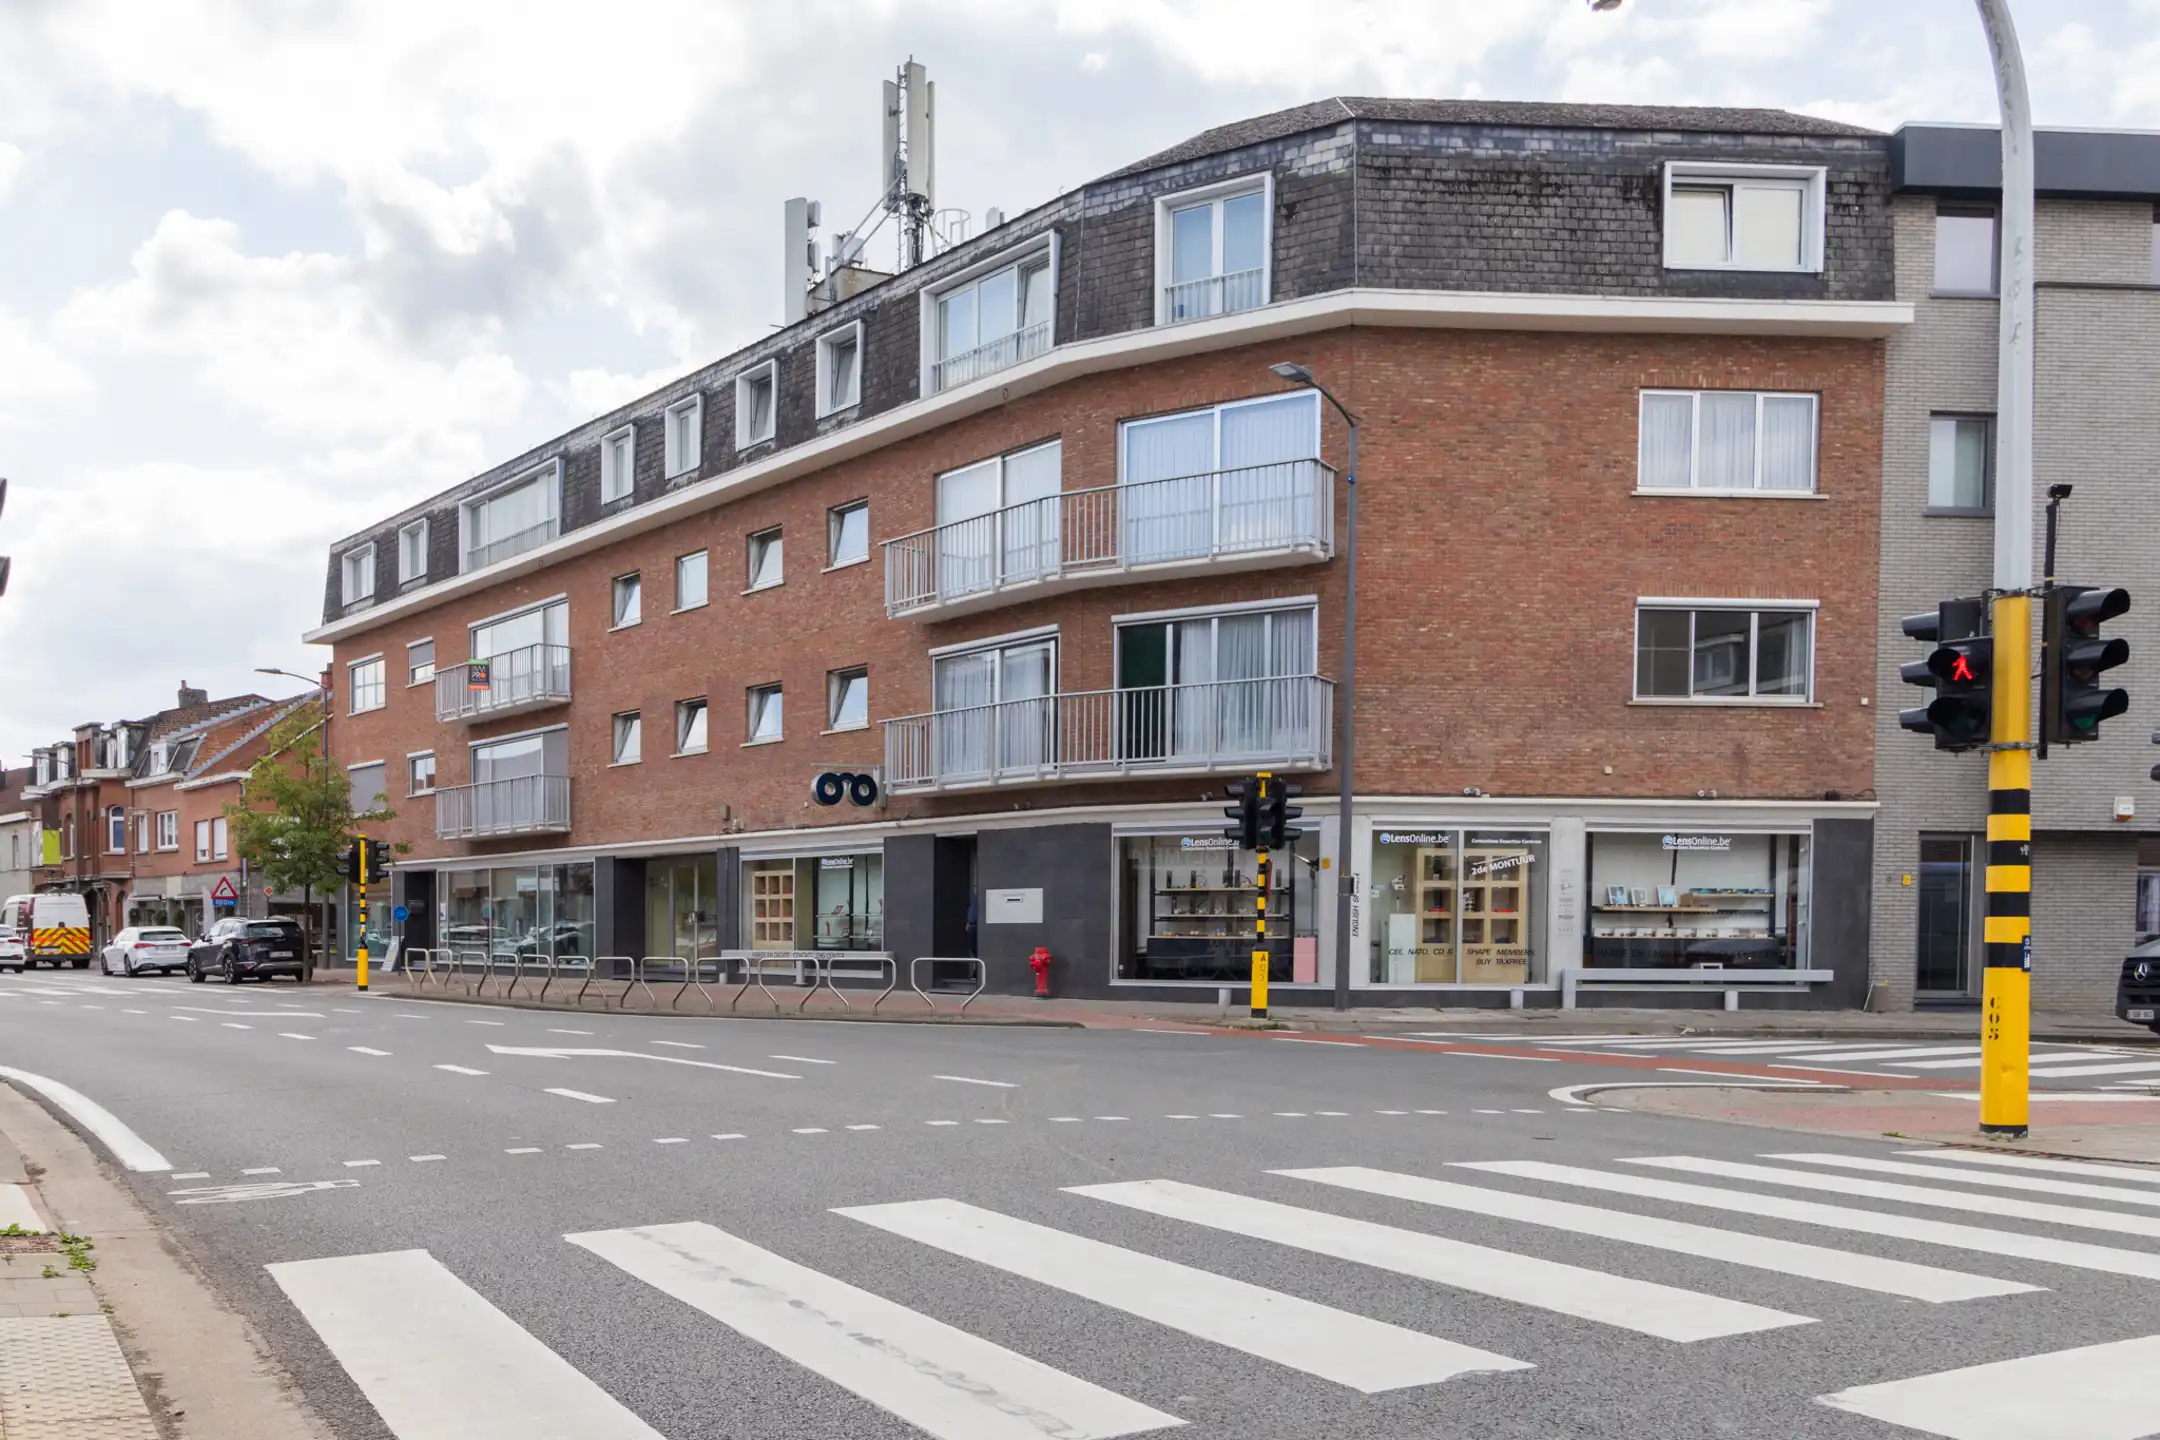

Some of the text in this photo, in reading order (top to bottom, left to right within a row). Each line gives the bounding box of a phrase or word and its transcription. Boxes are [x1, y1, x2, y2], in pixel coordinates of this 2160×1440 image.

[1191, 838, 1240, 847] LensOnline.b
[1390, 834, 1449, 844] LensOnline.be
[1673, 836, 1730, 846] LensOnline.be
[1470, 854, 1536, 876] 2de MONTUUR
[1352, 905, 1360, 938] ENGLISH
